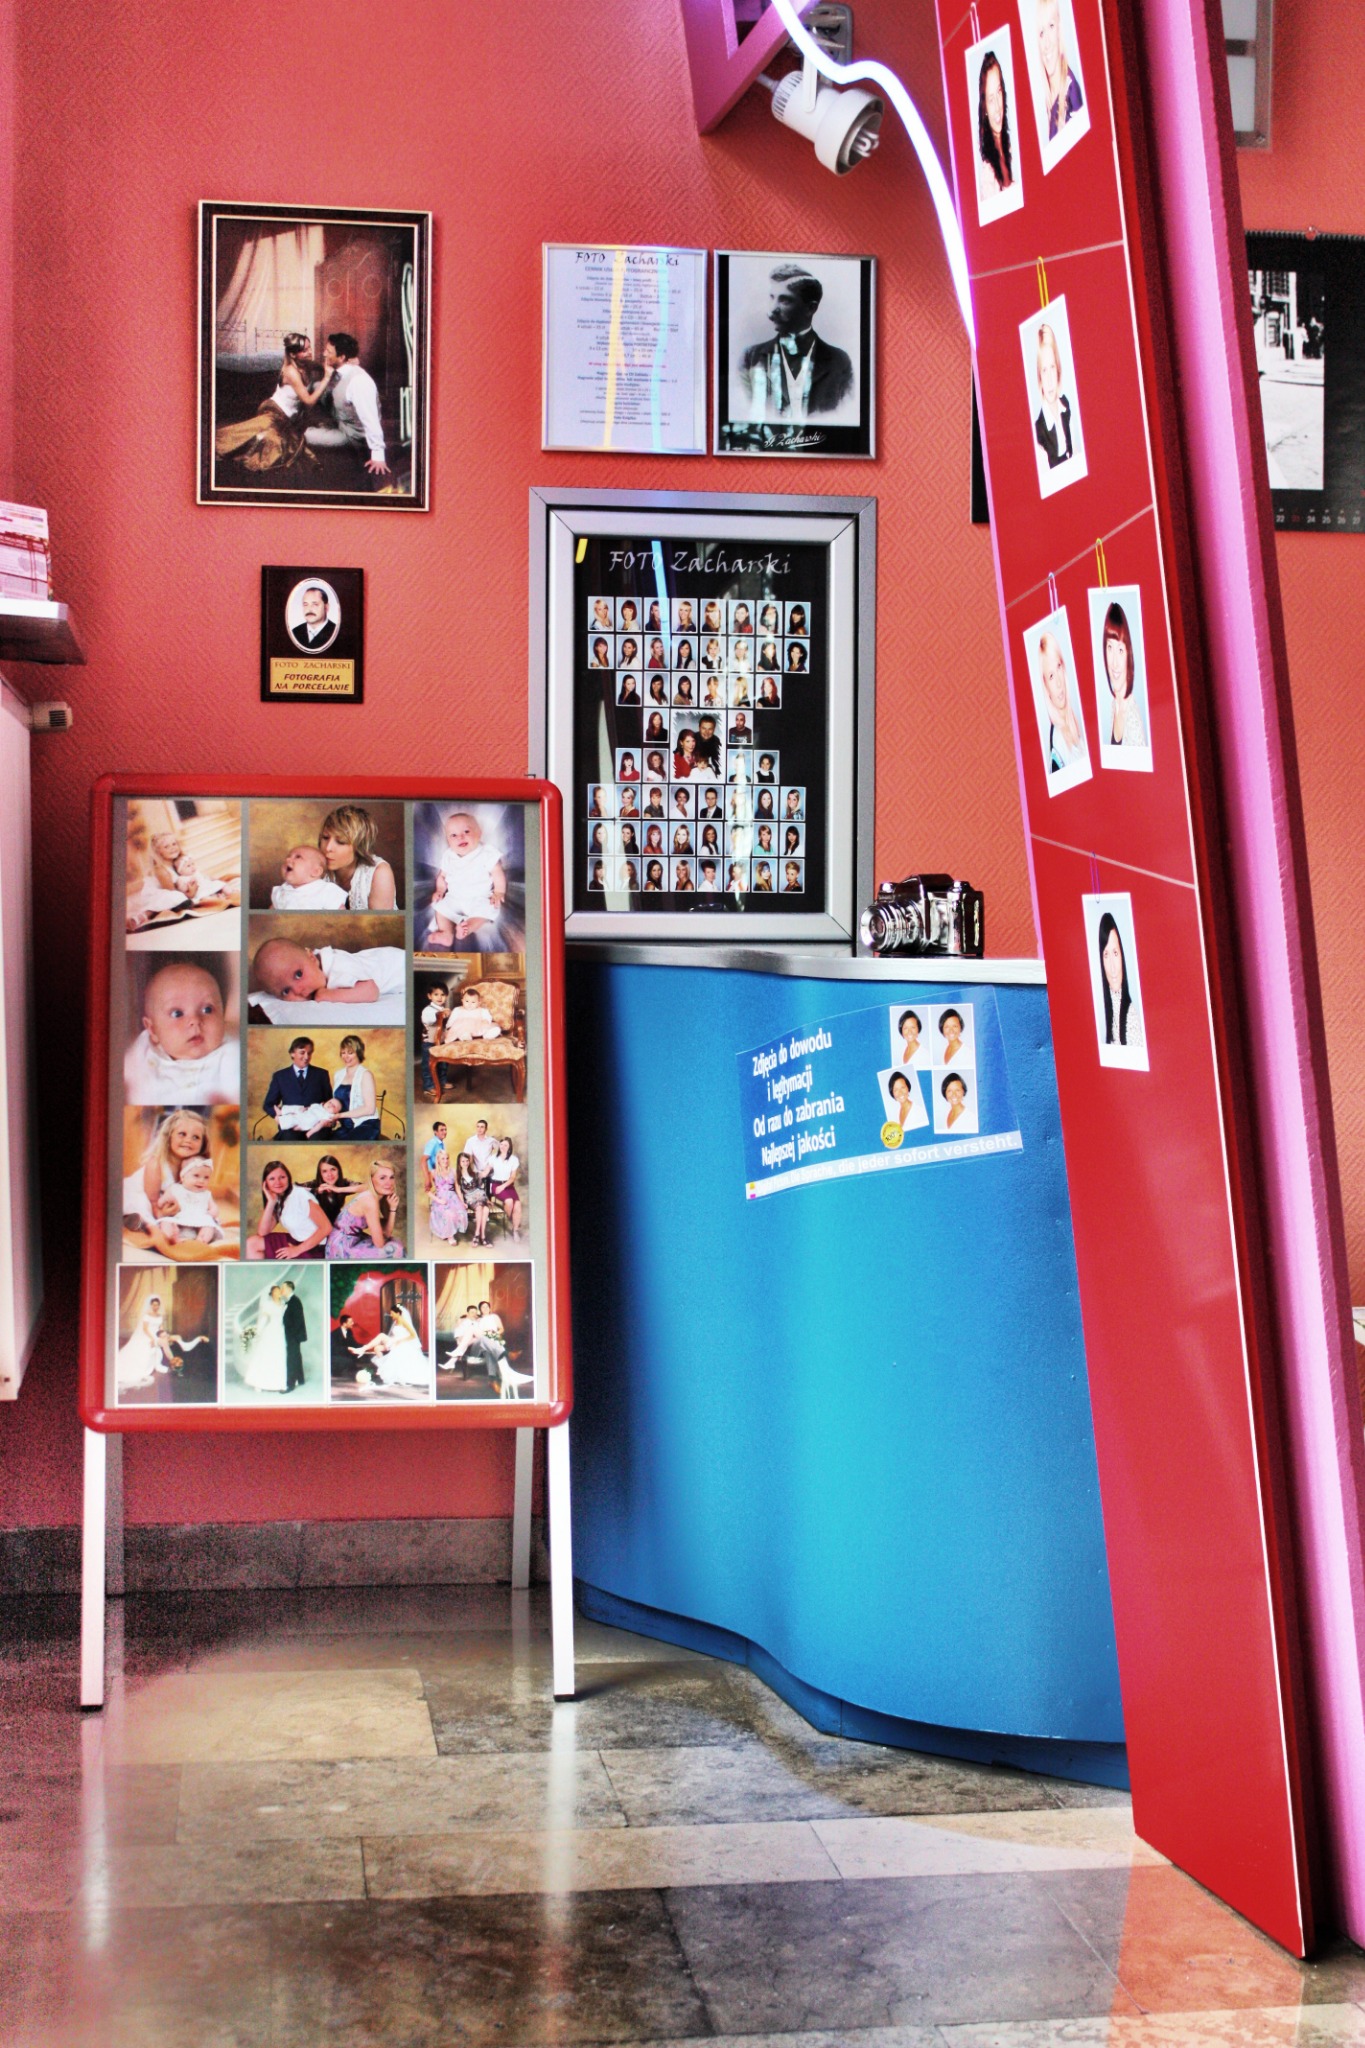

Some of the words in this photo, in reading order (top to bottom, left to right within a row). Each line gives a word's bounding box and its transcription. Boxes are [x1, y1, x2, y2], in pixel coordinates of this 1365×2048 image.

[575, 251, 606, 263] FOTO
[614, 252, 679, 266] acharki
[609, 550, 663, 571] FOTO
[671, 550, 791, 574] Zacharski
[274, 661, 299, 669] FOTO
[303, 661, 351, 669] ZACHARSKI
[284, 673, 340, 682] FOTOGRAFIA
[292, 683, 350, 691] PORCELANIE
[752, 1049, 777, 1079] Zdjęcia
[779, 1042, 788, 1064] do
[790, 1028, 832, 1059] dowodu
[767, 1081, 771, 1102] i
[772, 1064, 813, 1104] legitymacji
[753, 1114, 766, 1138] Od
[784, 1104, 793, 1126] do
[796, 1091, 845, 1122] zabrania
[761, 1135, 795, 1169] Najlepszej
[798, 1125, 836, 1161] jakości
[838, 1159, 855, 1174] die
[857, 1154, 890, 1174] jeder
[894, 1146, 940, 1164] sofort
[943, 1136, 1018, 1157] versteht.
